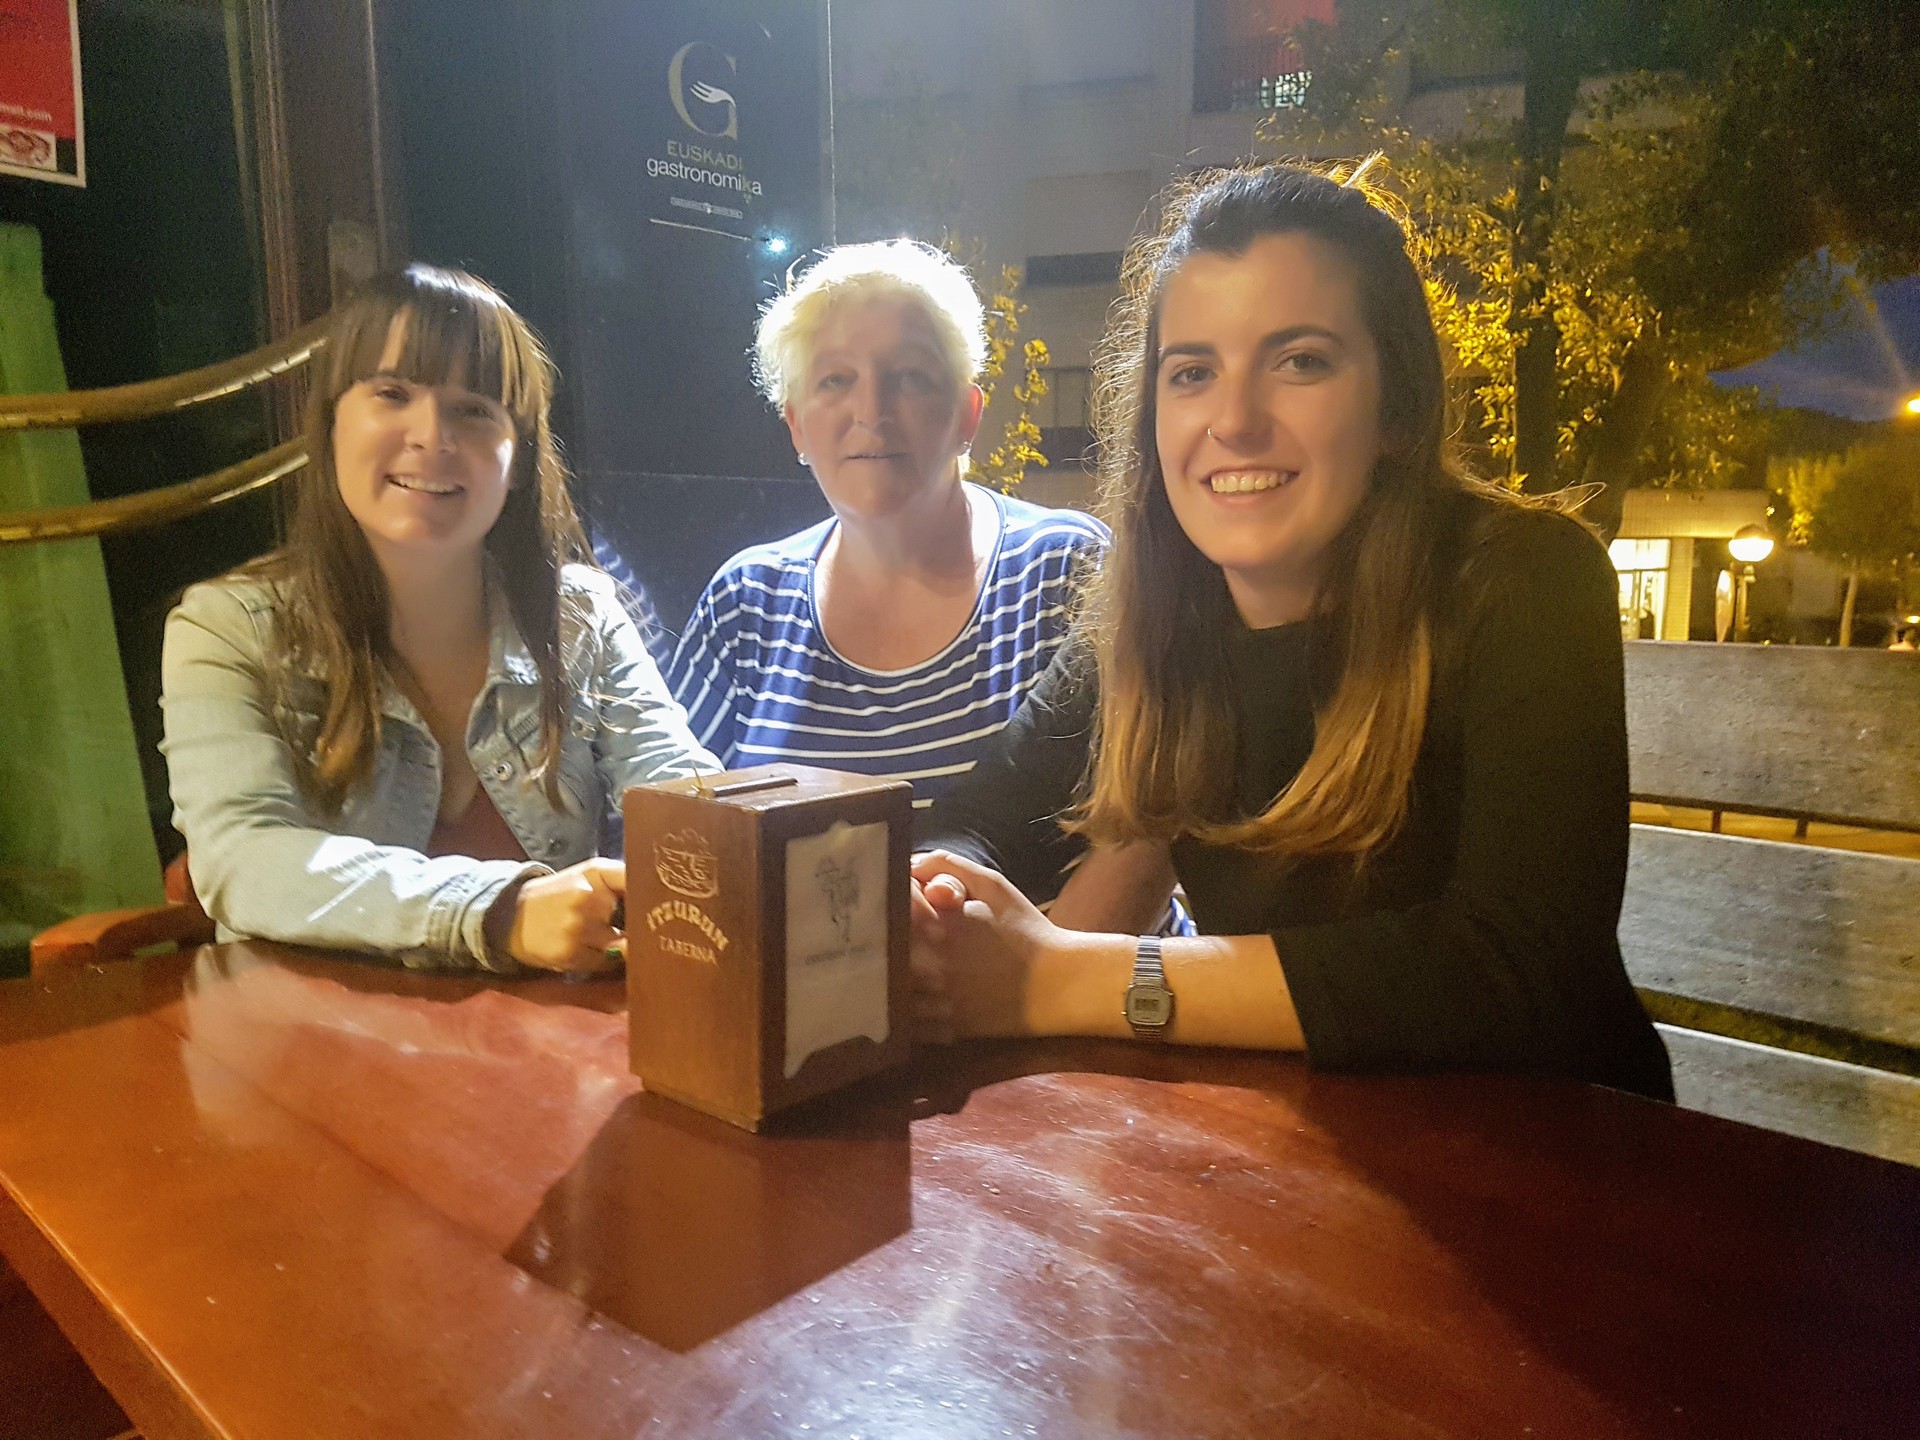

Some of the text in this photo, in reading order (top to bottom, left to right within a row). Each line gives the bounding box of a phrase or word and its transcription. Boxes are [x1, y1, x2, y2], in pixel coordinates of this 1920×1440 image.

[667, 140, 743, 171] EUSKADI
[646, 157, 763, 198] gastronomika
[658, 935, 719, 966] TABERNA
